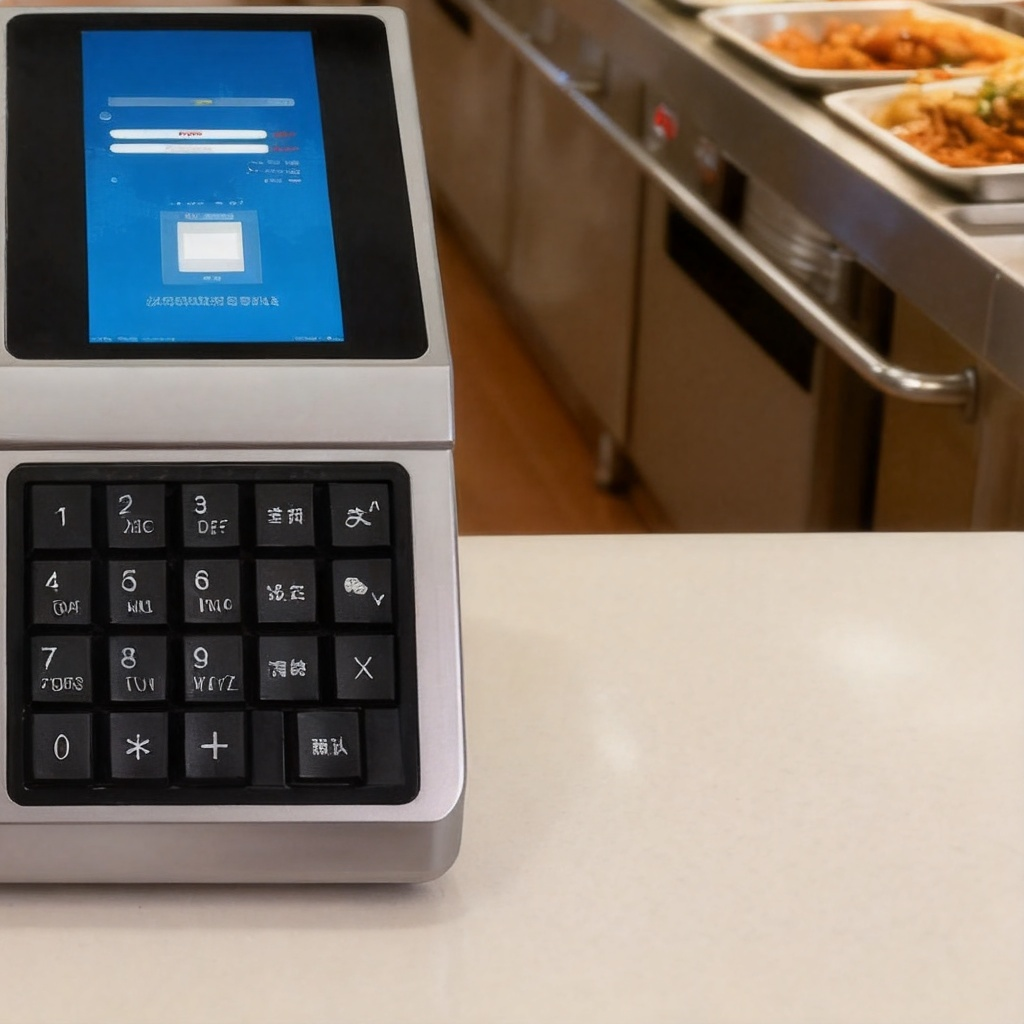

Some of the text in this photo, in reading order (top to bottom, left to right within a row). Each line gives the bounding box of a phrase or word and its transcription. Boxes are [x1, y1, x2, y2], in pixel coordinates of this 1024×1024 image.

[118, 494, 133, 515] 2
[194, 495, 207, 515] 3
[54, 507, 66, 527] 1
[45, 571, 59, 592] 4
[194, 569, 210, 591] 6
[41, 647, 58, 670] 7
[120, 647, 136, 669] 8
[193, 646, 209, 669] 9
[53, 733, 70, 760] 0
